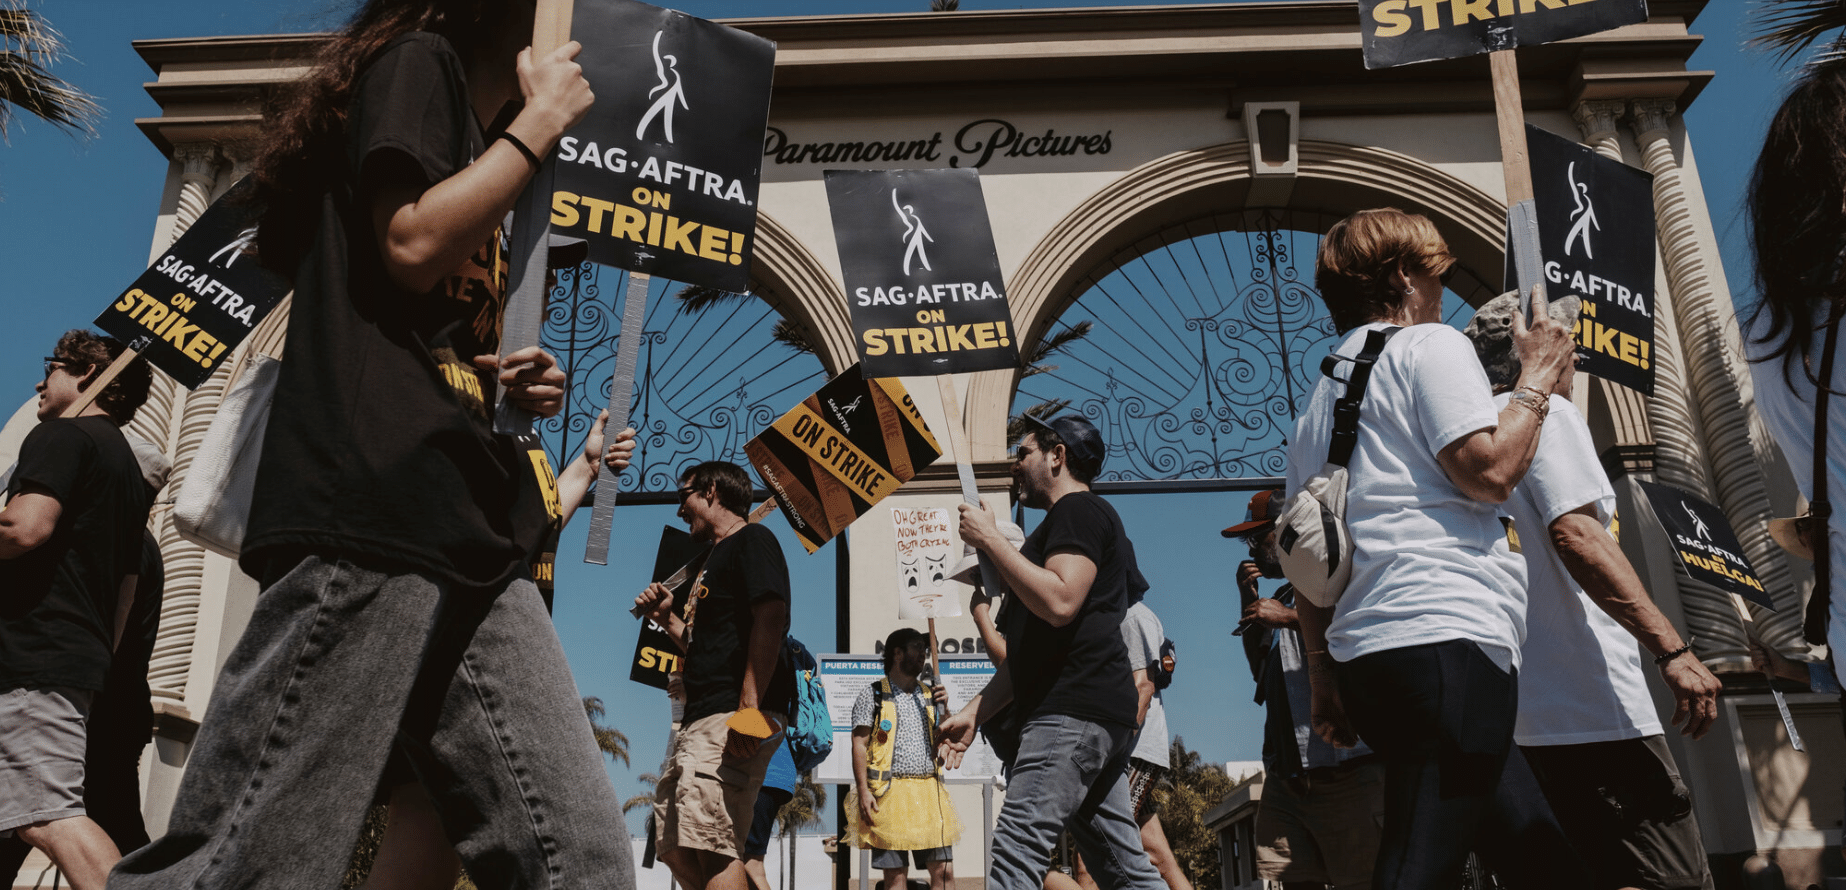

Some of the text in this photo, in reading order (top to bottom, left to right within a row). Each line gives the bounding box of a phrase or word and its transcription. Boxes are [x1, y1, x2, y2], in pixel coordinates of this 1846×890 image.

[763, 118, 1112, 168] Paramount Pictures
[631, 187, 671, 211] ON
[550, 190, 745, 266] STRIKE!
[170, 292, 197, 314] ON
[916, 309, 946, 324] ON
[114, 288, 228, 369] STRIKE!
[862, 321, 1011, 356] STRIKE!
[792, 414, 886, 497] ON STRIKE
[762, 464, 806, 529] #SAGAFTRASTRONG
[893, 510, 938, 525] OH GREAT
[897, 527, 917, 539] NOW
[897, 540, 918, 552] BOTH
[1680, 550, 1765, 592] HUELGA!
